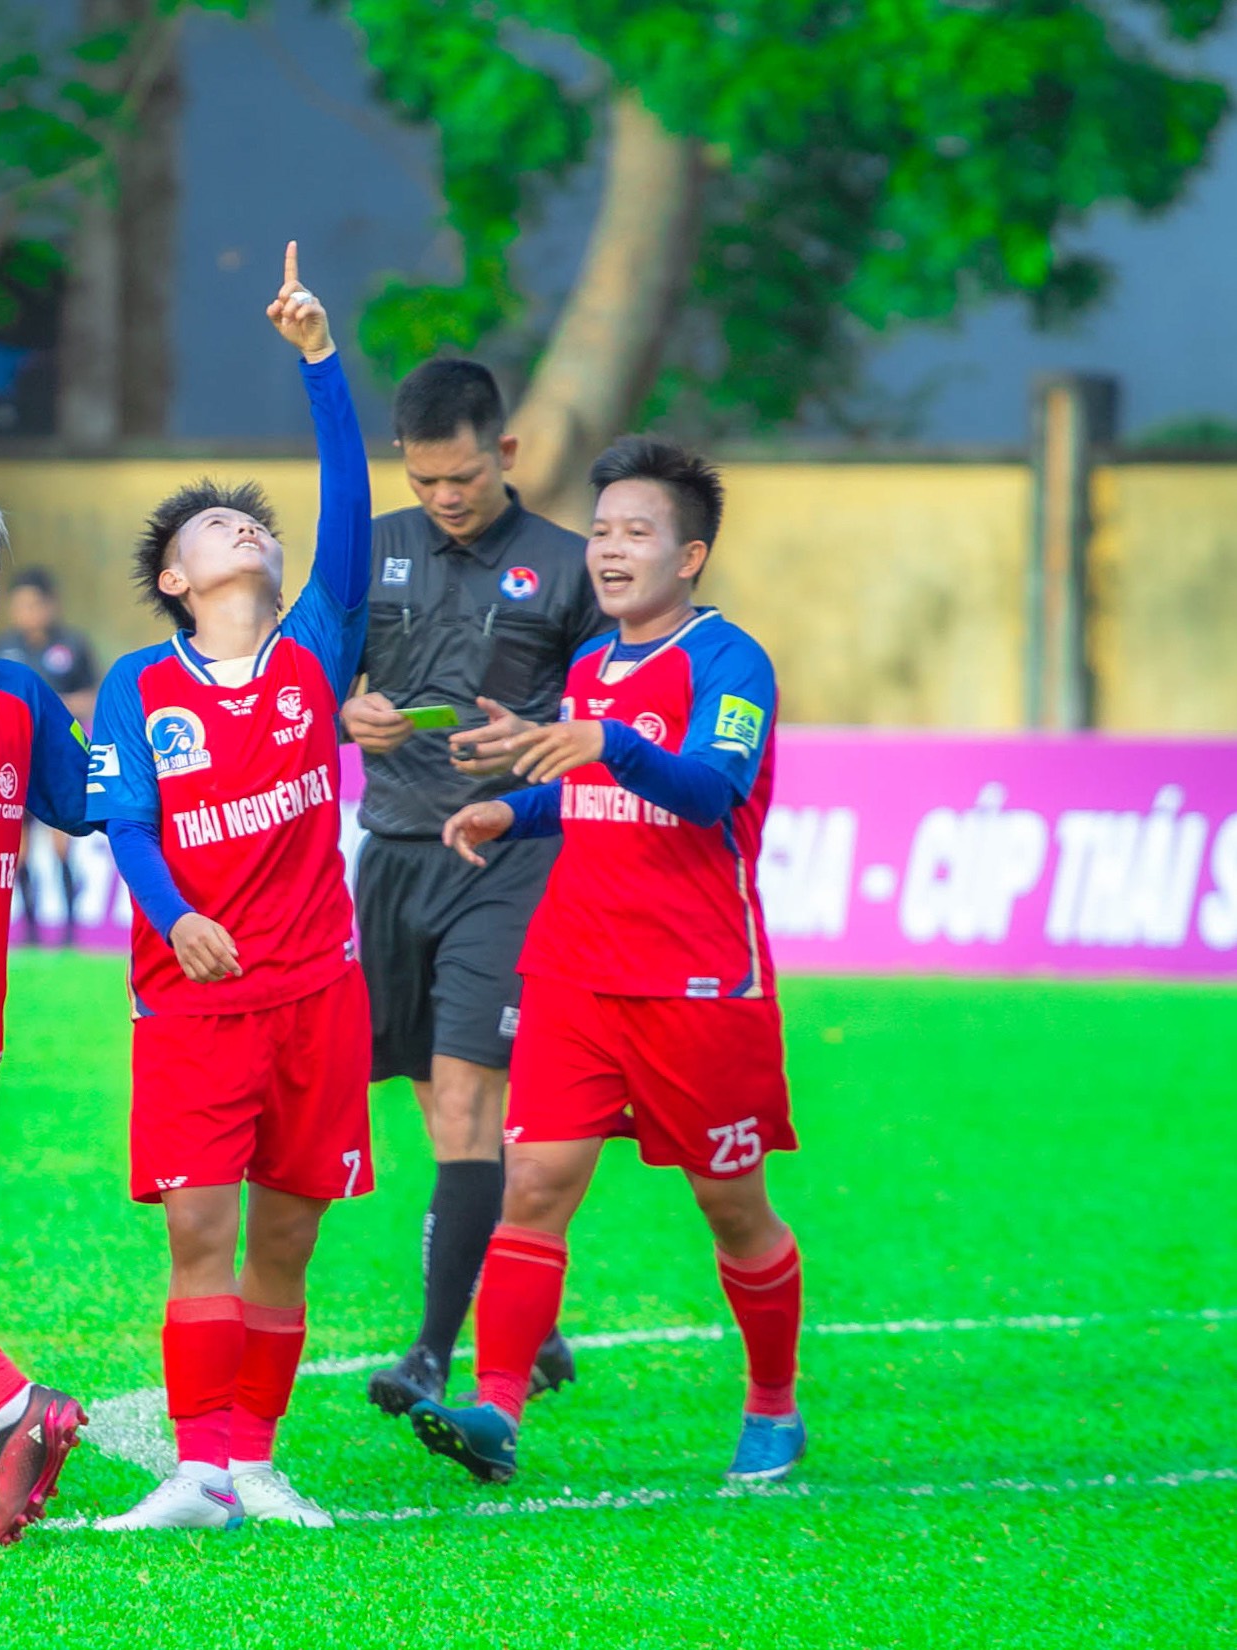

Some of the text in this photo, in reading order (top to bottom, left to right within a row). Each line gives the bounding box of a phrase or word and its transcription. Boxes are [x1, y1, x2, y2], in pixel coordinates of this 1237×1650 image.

[172, 764, 333, 849] THÁI NGUYÊN T&T
[0, 852, 18, 890] T&
[899, 780, 1050, 946] CÚP
[1044, 783, 1210, 948] THÁI
[707, 1116, 762, 1173] 25
[342, 1149, 361, 1198] 7
